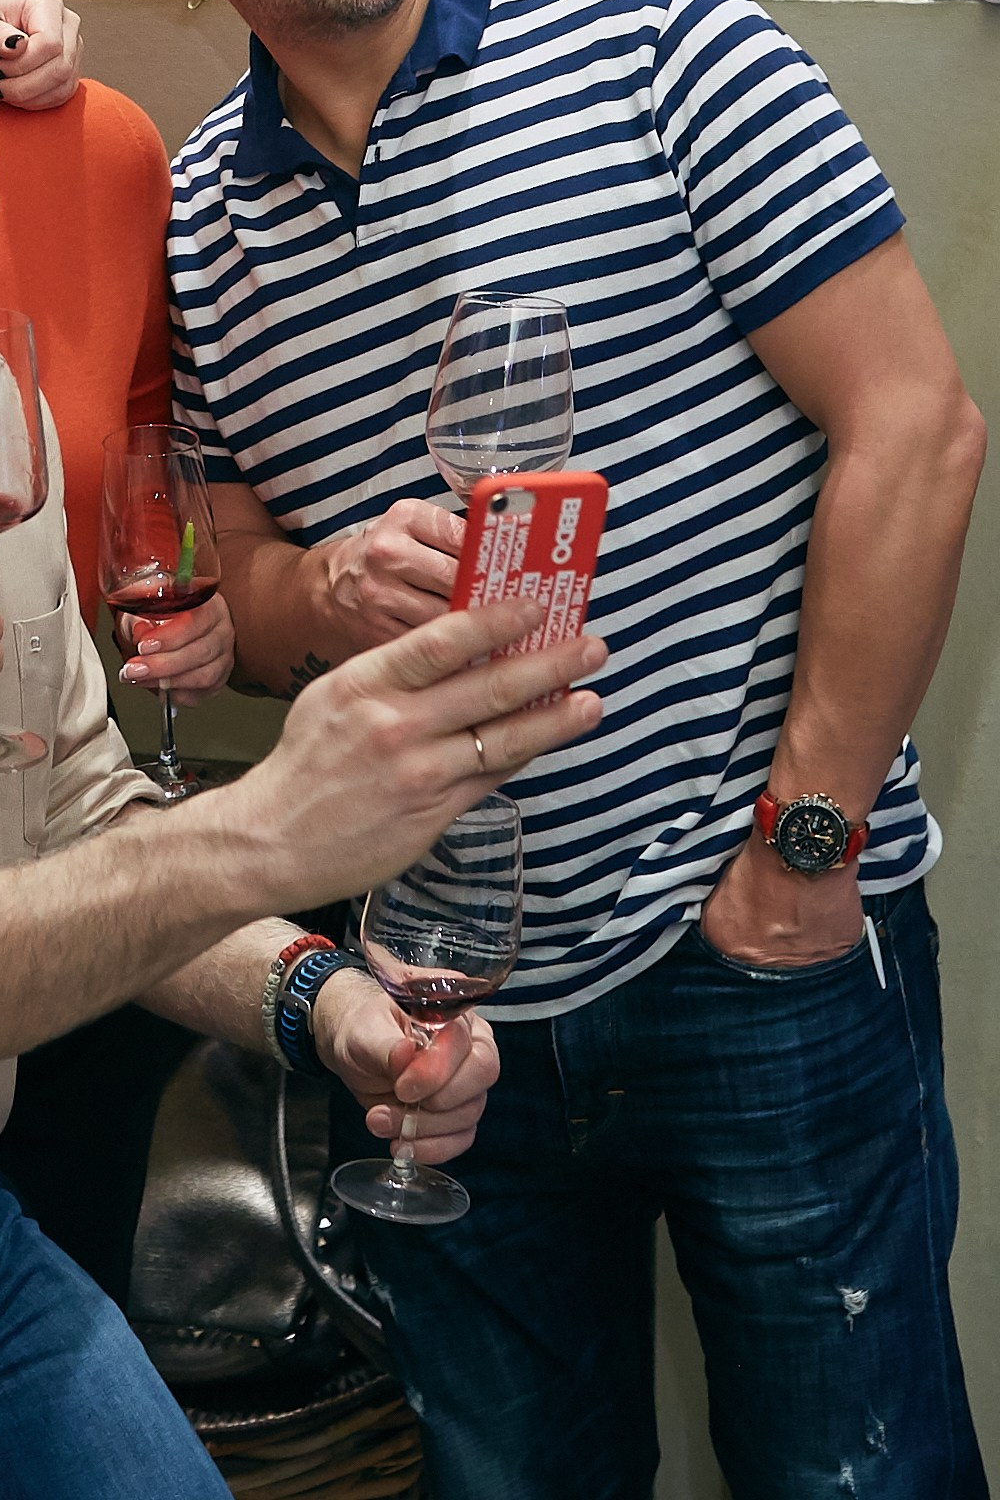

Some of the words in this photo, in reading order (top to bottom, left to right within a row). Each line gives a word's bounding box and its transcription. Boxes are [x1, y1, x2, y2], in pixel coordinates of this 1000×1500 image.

[551, 497, 583, 565] BBDO
[475, 529, 494, 576] WORK
[493, 529, 509, 574] WORK
[510, 526, 530, 573] WORK
[506, 577, 520, 600] TH
[524, 576, 537, 599] TH
[555, 574, 571, 606] THE
[571, 573, 589, 606] THE
[565, 607, 583, 639] WOR
